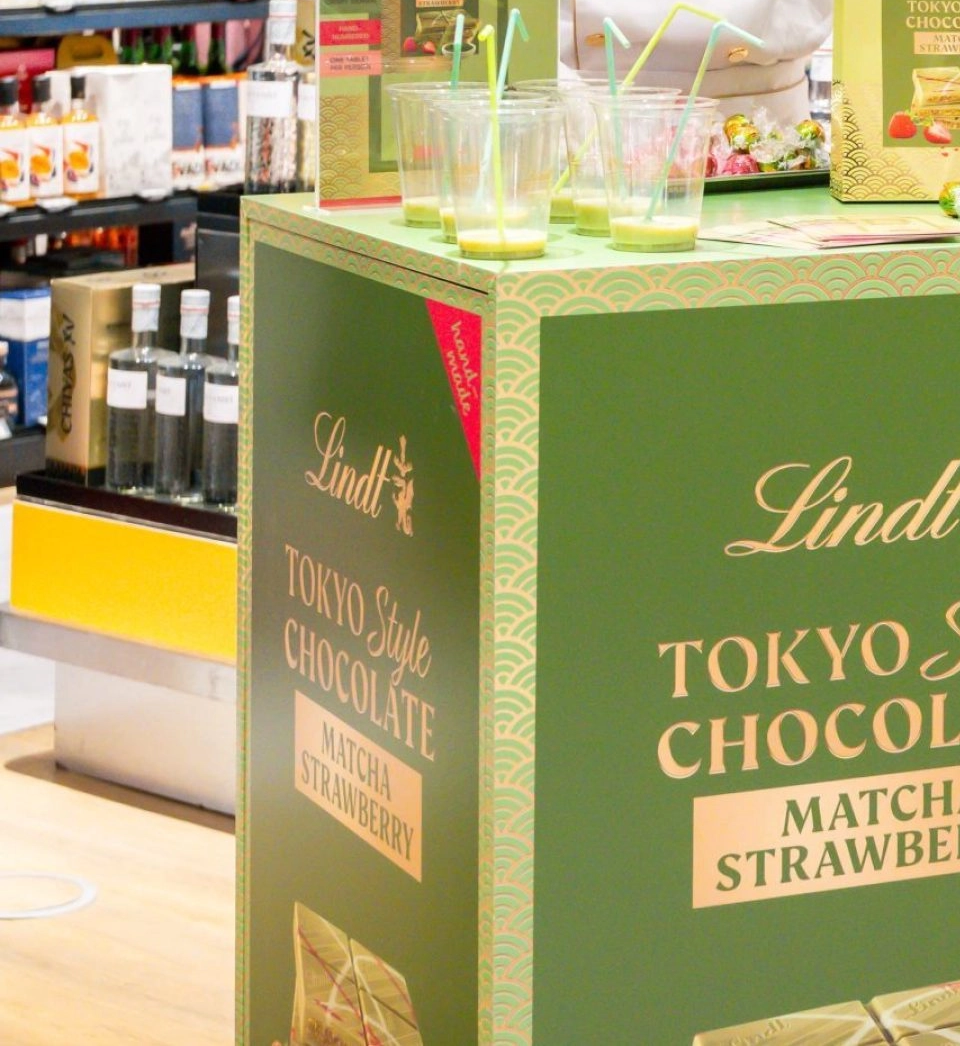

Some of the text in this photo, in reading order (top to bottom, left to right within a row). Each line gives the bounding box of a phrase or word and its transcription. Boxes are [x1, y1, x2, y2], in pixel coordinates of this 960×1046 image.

[61, 352, 75, 434] CHIVAS
[447, 350, 471, 416] made
[305, 412, 392, 518] Lindt
[285, 543, 432, 686] TOKYO Style
[658, 620, 910, 698] TOKYO
[284, 618, 435, 762] CHOCOLATE
[301, 750, 414, 861] STRAWBERRY
[321, 721, 391, 802] MATCHA
